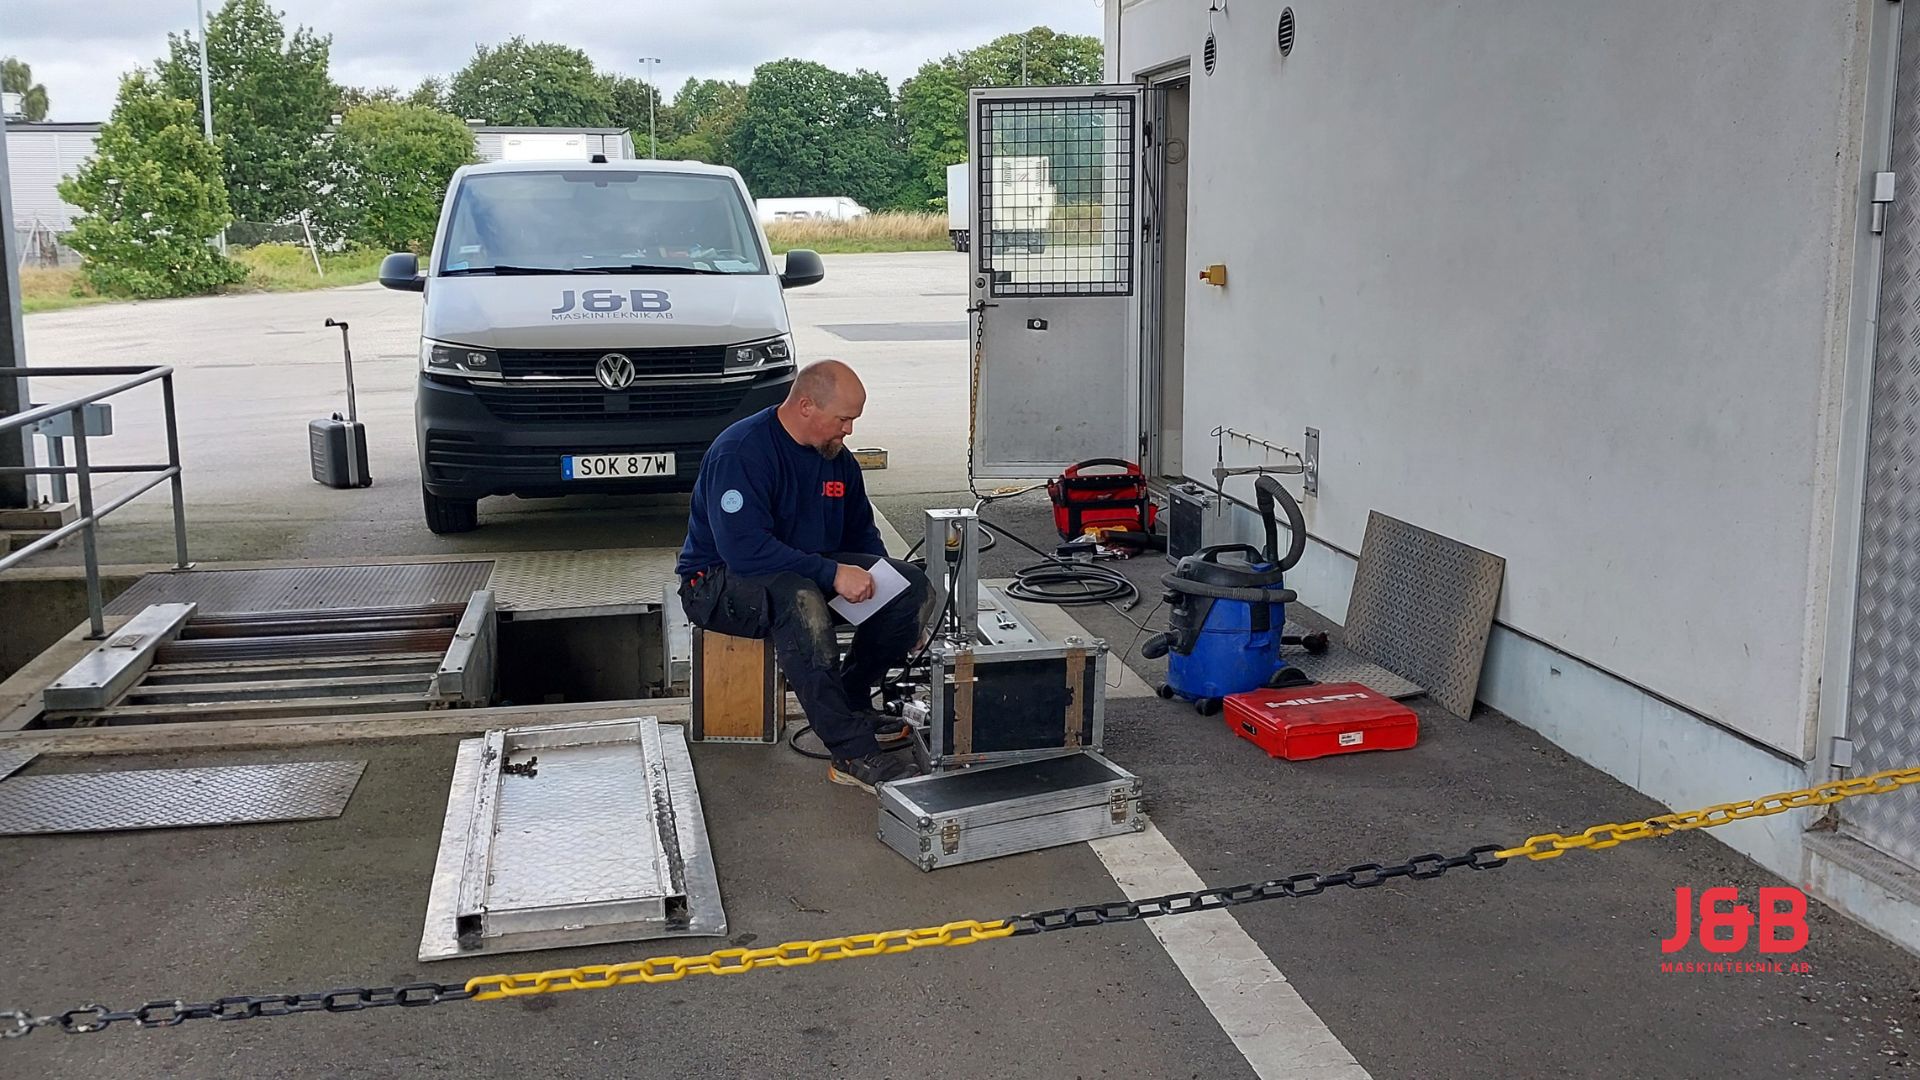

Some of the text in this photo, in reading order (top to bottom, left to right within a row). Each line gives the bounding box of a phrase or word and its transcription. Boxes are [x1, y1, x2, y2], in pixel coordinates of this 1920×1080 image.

[552, 289, 672, 314] J&B
[551, 312, 651, 321] MASKINTEKNIK
[581, 455, 667, 476] SOK 87W
[1264, 692, 1369, 708] HILTI
